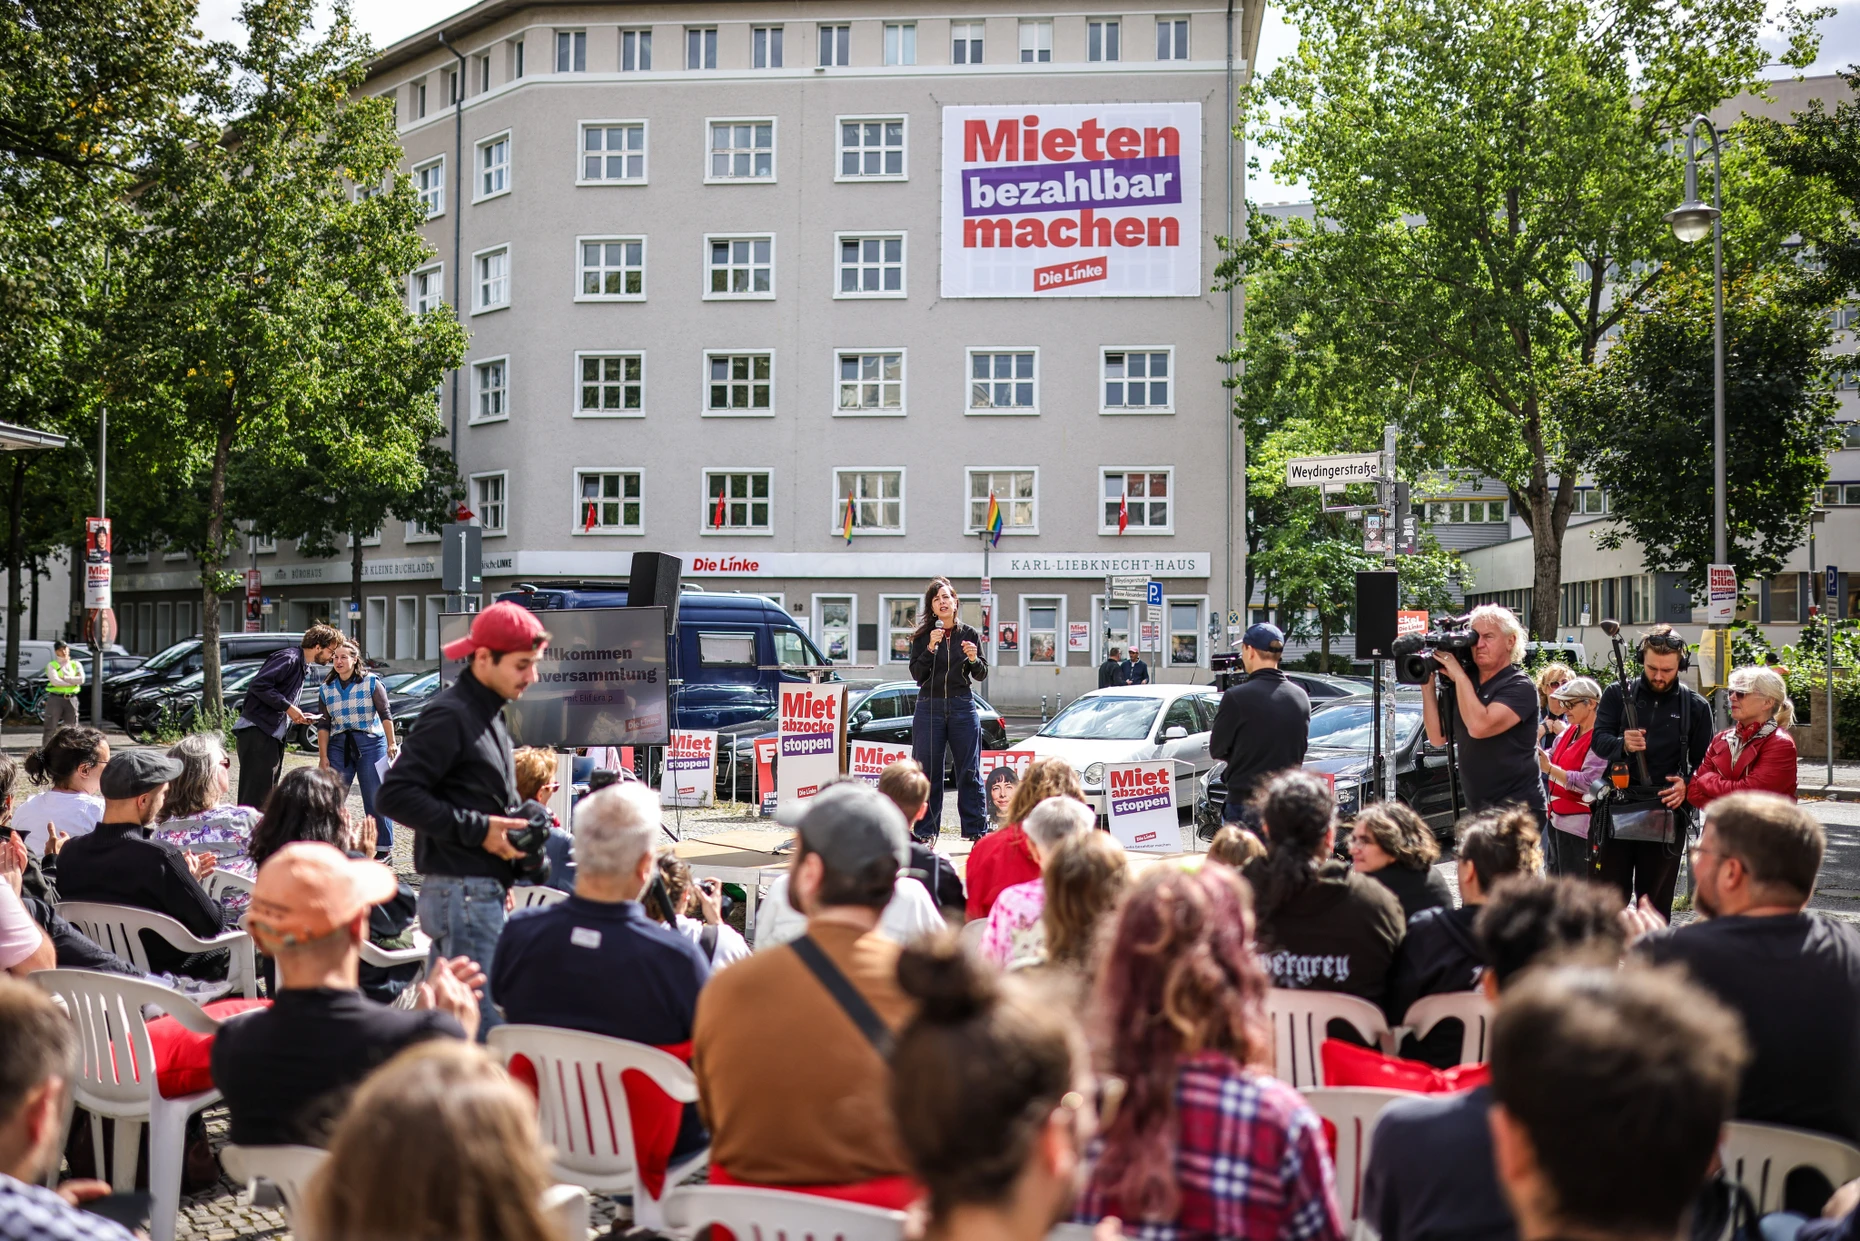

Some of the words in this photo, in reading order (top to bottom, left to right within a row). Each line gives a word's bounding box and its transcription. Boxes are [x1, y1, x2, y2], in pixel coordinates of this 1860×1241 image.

[964, 115, 1180, 162] Mieten
[970, 168, 1173, 208] bezahlbar
[963, 209, 1180, 248] machen
[1039, 271, 1062, 286] Die
[1065, 264, 1103, 282] Linke
[1291, 461, 1377, 480] Weydingerstraße
[360, 566, 369, 576] ER
[370, 564, 393, 575] KLEINE
[395, 562, 435, 573] BUCHLADEN
[693, 557, 717, 571] Die
[719, 555, 759, 571] Linke
[1011, 559, 1196, 571] KARL-LIEBKNECHT-HAUS
[291, 568, 322, 579] BÜROHAUS
[1150, 584, 1158, 602] P
[1398, 616, 1419, 624] ckel
[543, 648, 633, 661] illkommen
[537, 667, 658, 683] nversammlung
[565, 694, 578, 702] mit
[782, 691, 836, 719] Miet
[782, 719, 834, 733] abzocke
[668, 735, 712, 750] Miet
[784, 737, 832, 753] stoppen
[668, 760, 708, 770] stoppen
[854, 763, 883, 774] abzo
[1110, 767, 1170, 788] Miet
[1111, 785, 1170, 798] abzocke
[1115, 795, 1168, 814] stoppen
